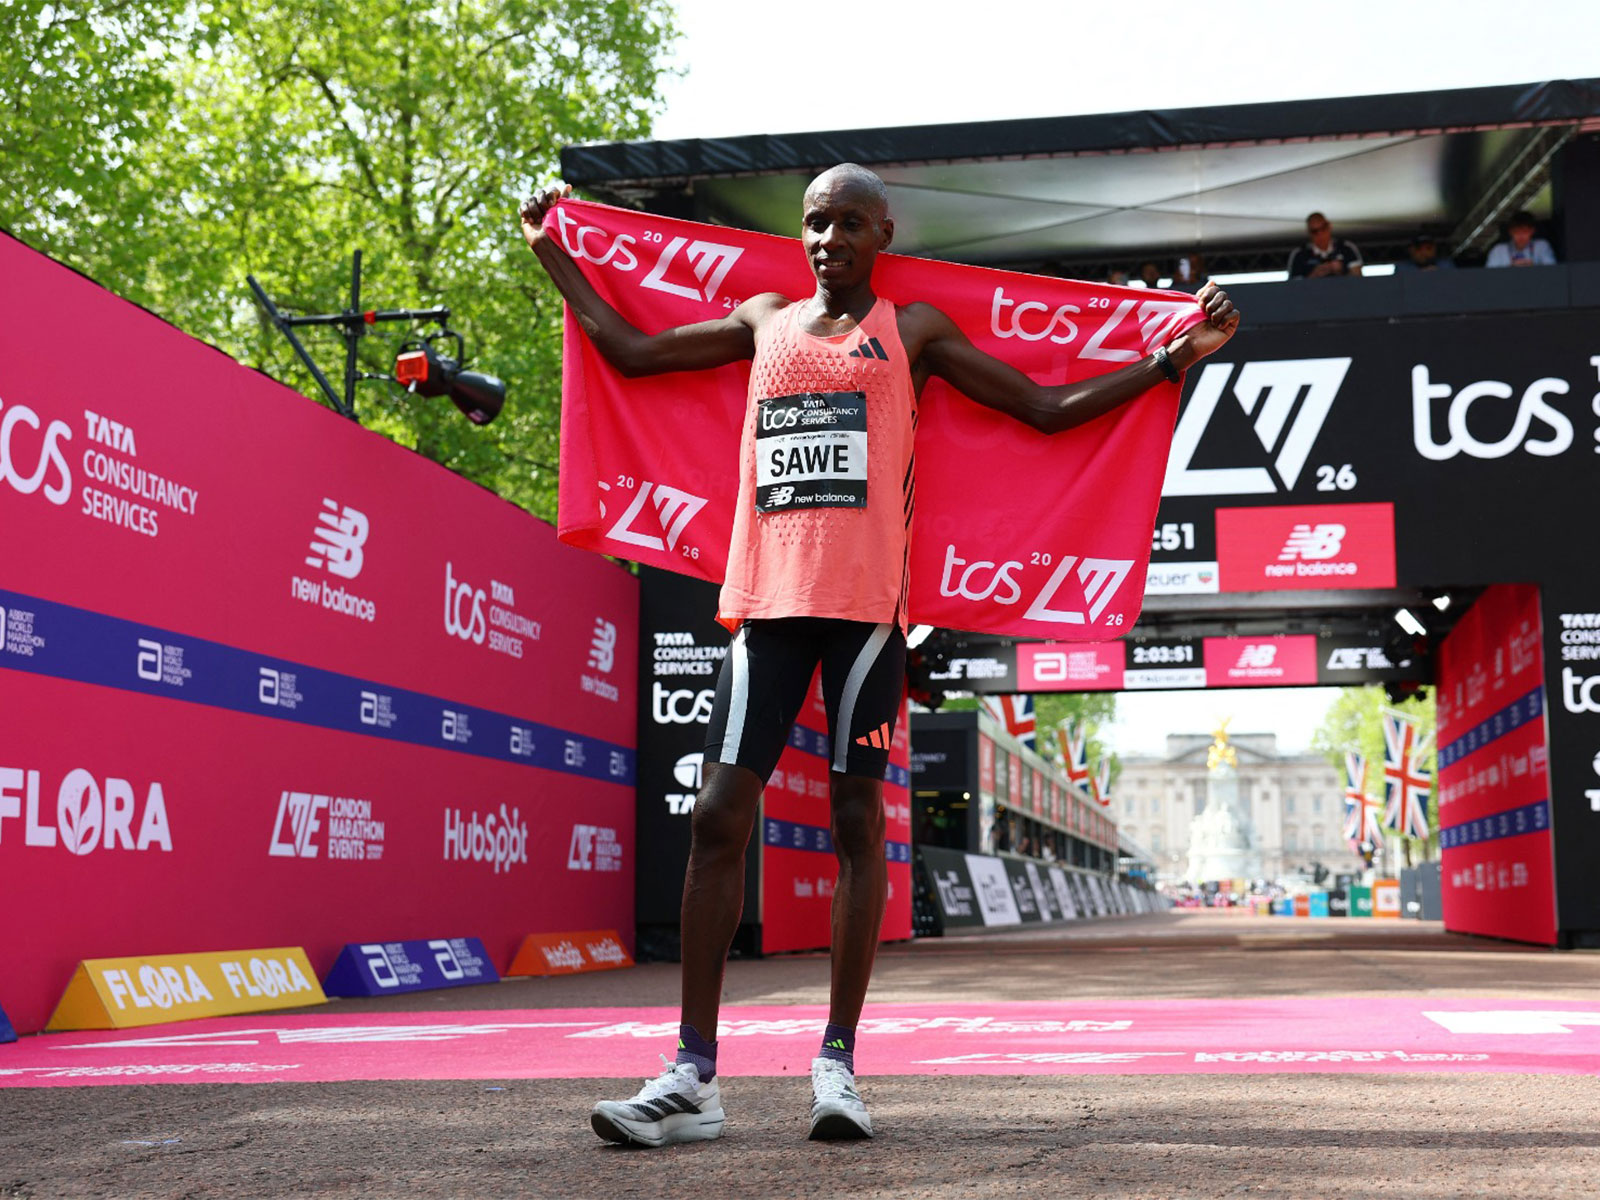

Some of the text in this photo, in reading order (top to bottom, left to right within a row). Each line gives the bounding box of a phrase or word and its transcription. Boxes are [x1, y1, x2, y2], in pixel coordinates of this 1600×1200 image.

[557, 206, 638, 271] tcs
[643, 230, 663, 243] 20
[1088, 297, 1110, 309] 20
[991, 286, 1081, 344] tcs
[801, 407, 859, 417] CONSULTANCY
[802, 399, 826, 408] TATA
[1412, 364, 1574, 461] tcs
[762, 406, 798, 430] tcs
[801, 415, 838, 426] SERVICES
[84, 409, 137, 457] TATA
[0, 398, 72, 505] cs
[771, 445, 849, 477] SAWE
[83, 449, 198, 515] CONSULTANCY
[616, 474, 634, 489] 20
[1316, 464, 1357, 491] 26
[794, 492, 856, 504] new balance
[82, 486, 158, 537] SERVICES
[682, 546, 699, 560] 26
[1031, 552, 1051, 566] 20
[940, 544, 1024, 605] tcs
[1147, 571, 1190, 587] euer
[1265, 561, 1357, 577] new balance
[292, 575, 376, 622] new balance
[444, 560, 487, 645] tcs
[491, 579, 515, 607] TATA
[7, 622, 33, 635] WORLD
[1105, 614, 1123, 626] 26
[654, 633, 695, 646] TATA
[653, 648, 729, 661] CONSULTAN
[1134, 646, 1193, 662] 2:03:51
[653, 662, 714, 675] SERVICES
[1562, 667, 1600, 713] tc
[329, 797, 372, 819] LONDON
[665, 794, 697, 815] TA
[328, 818, 385, 841] MARATHON
[443, 803, 528, 874] HubSpot
[328, 838, 365, 859] EVENTS
[102, 957, 312, 1010] FLORA FLORA
